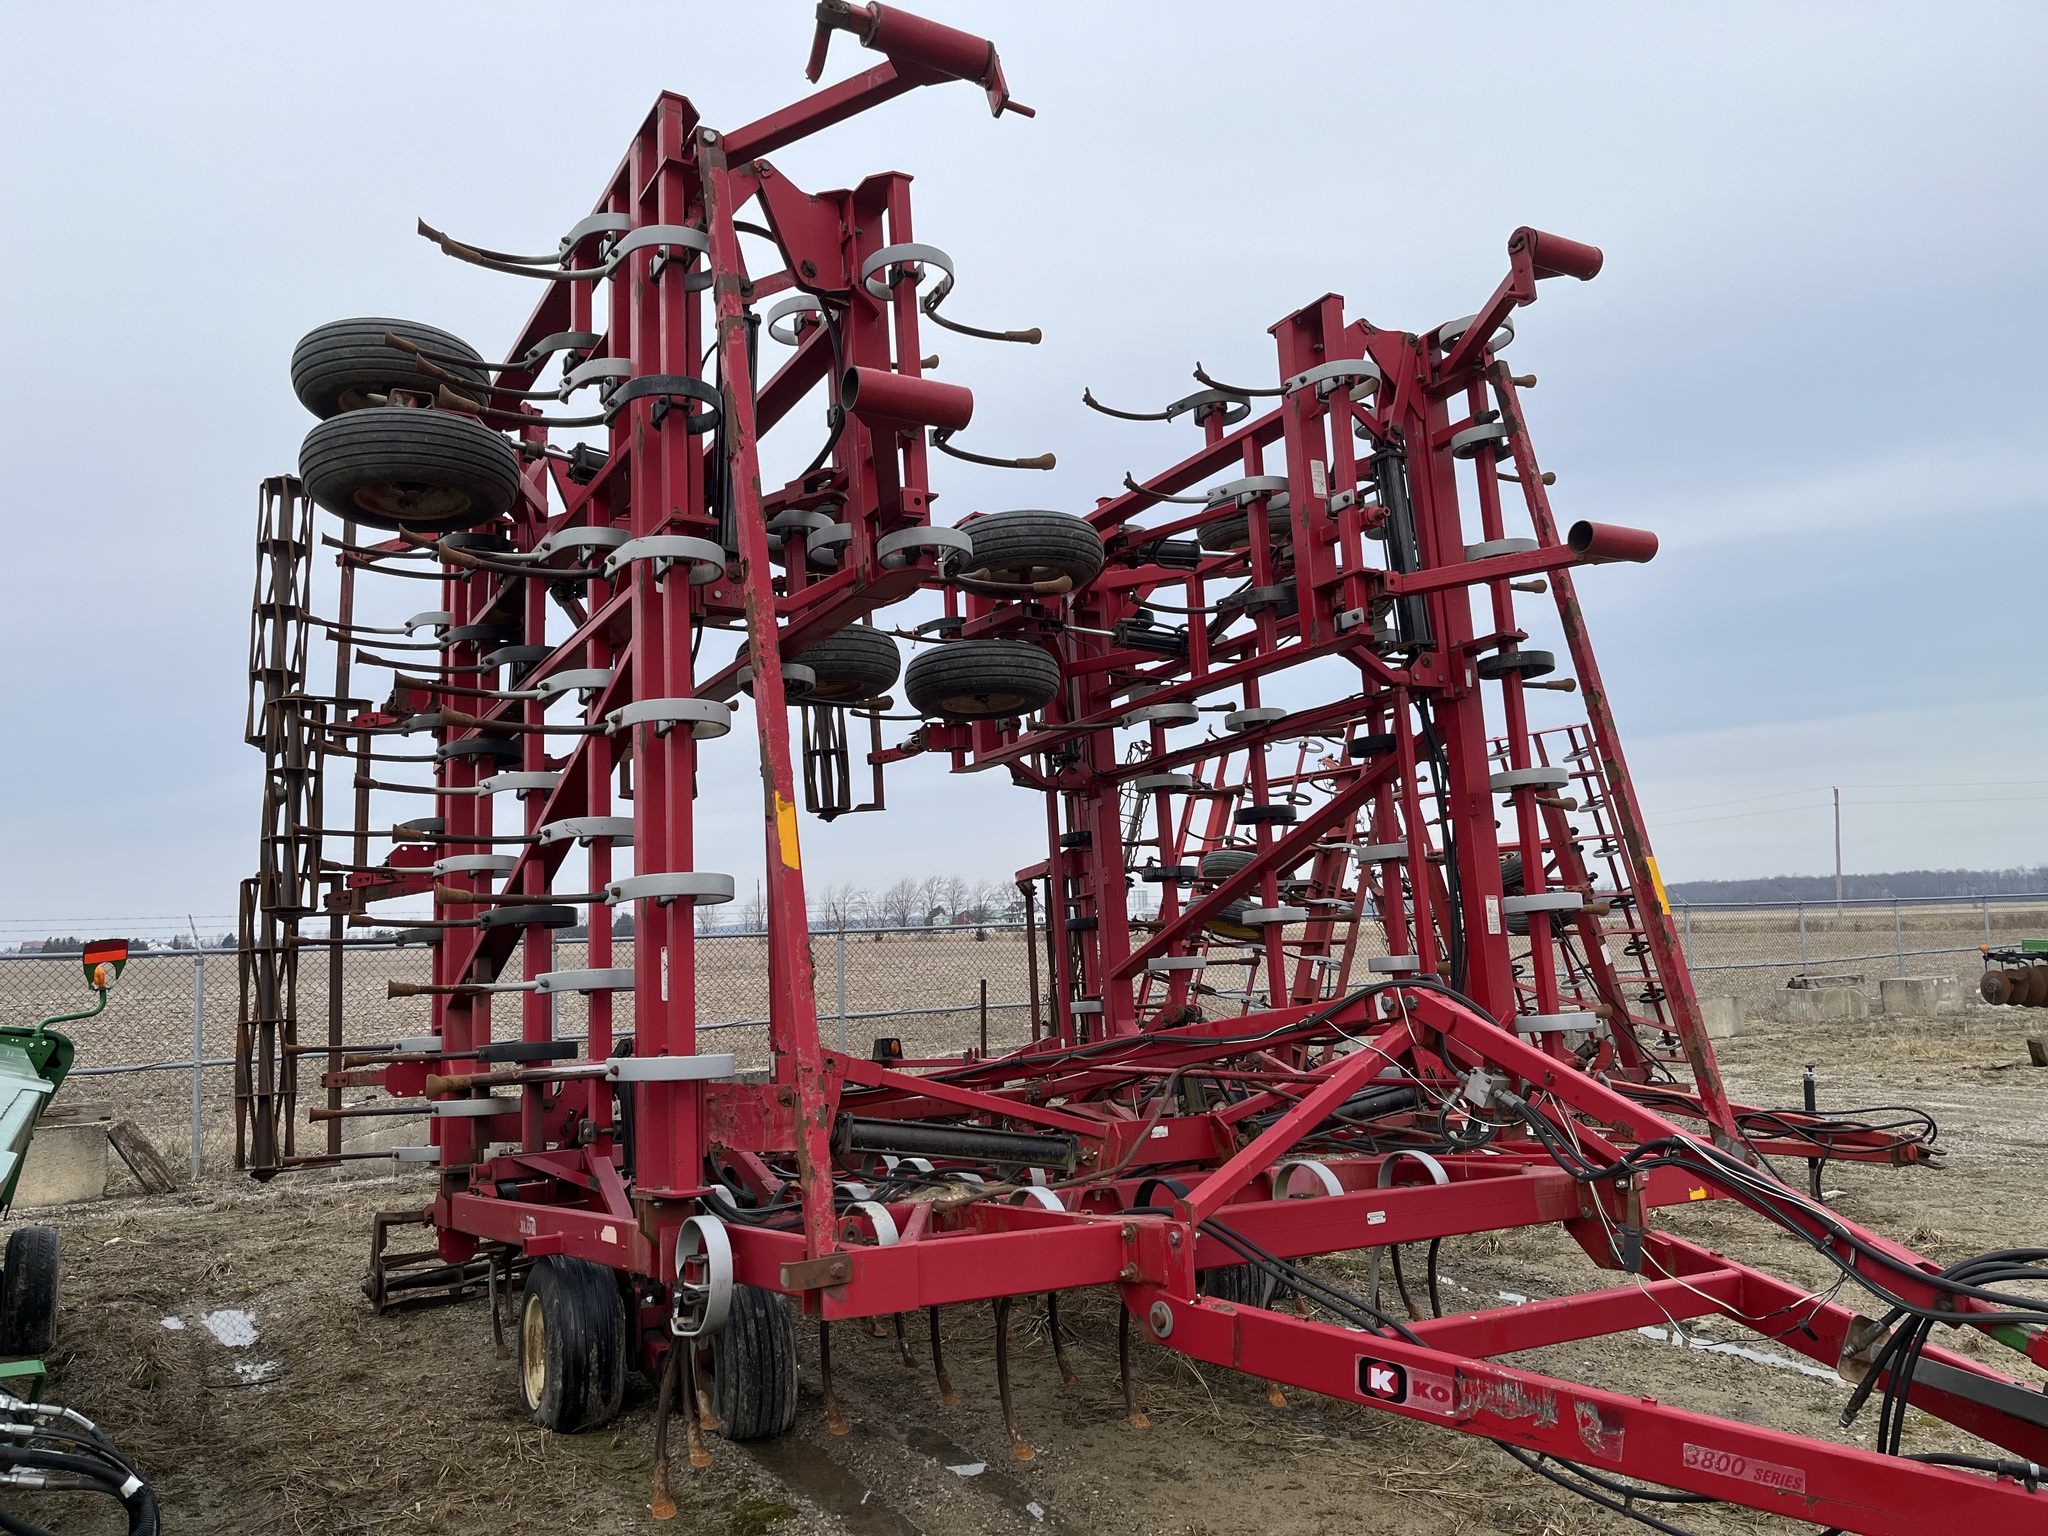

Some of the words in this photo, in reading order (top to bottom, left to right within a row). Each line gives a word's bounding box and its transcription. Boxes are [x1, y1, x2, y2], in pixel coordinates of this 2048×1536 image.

[1370, 1367, 1395, 1394] K
[1685, 1445, 1746, 1477] 3800
[1753, 1468, 1804, 1490] SERIES
